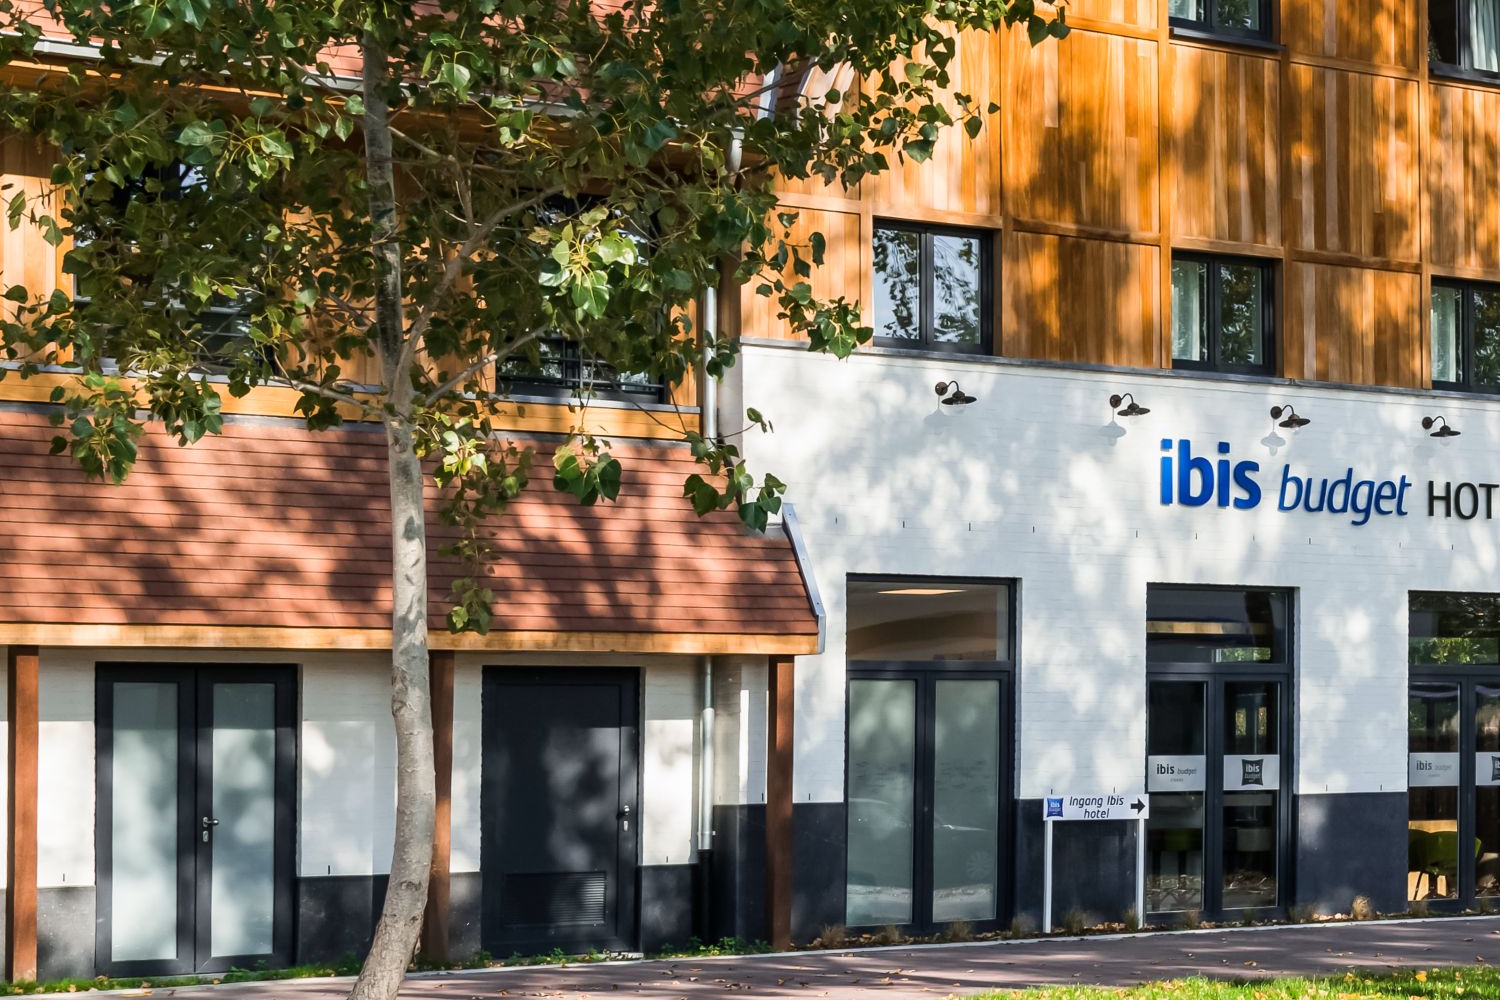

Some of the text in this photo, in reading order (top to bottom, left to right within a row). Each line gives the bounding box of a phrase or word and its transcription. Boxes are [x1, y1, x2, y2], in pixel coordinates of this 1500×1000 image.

[1160, 438, 1262, 509] ibis
[1277, 463, 1412, 526] budget
[1156, 763, 1175, 775] ibis
[1245, 763, 1260, 772] ibis
[1416, 760, 1432, 771] ibis
[1069, 795, 1124, 808] Ingang Ibis
[1083, 808, 1110, 819] hotel
